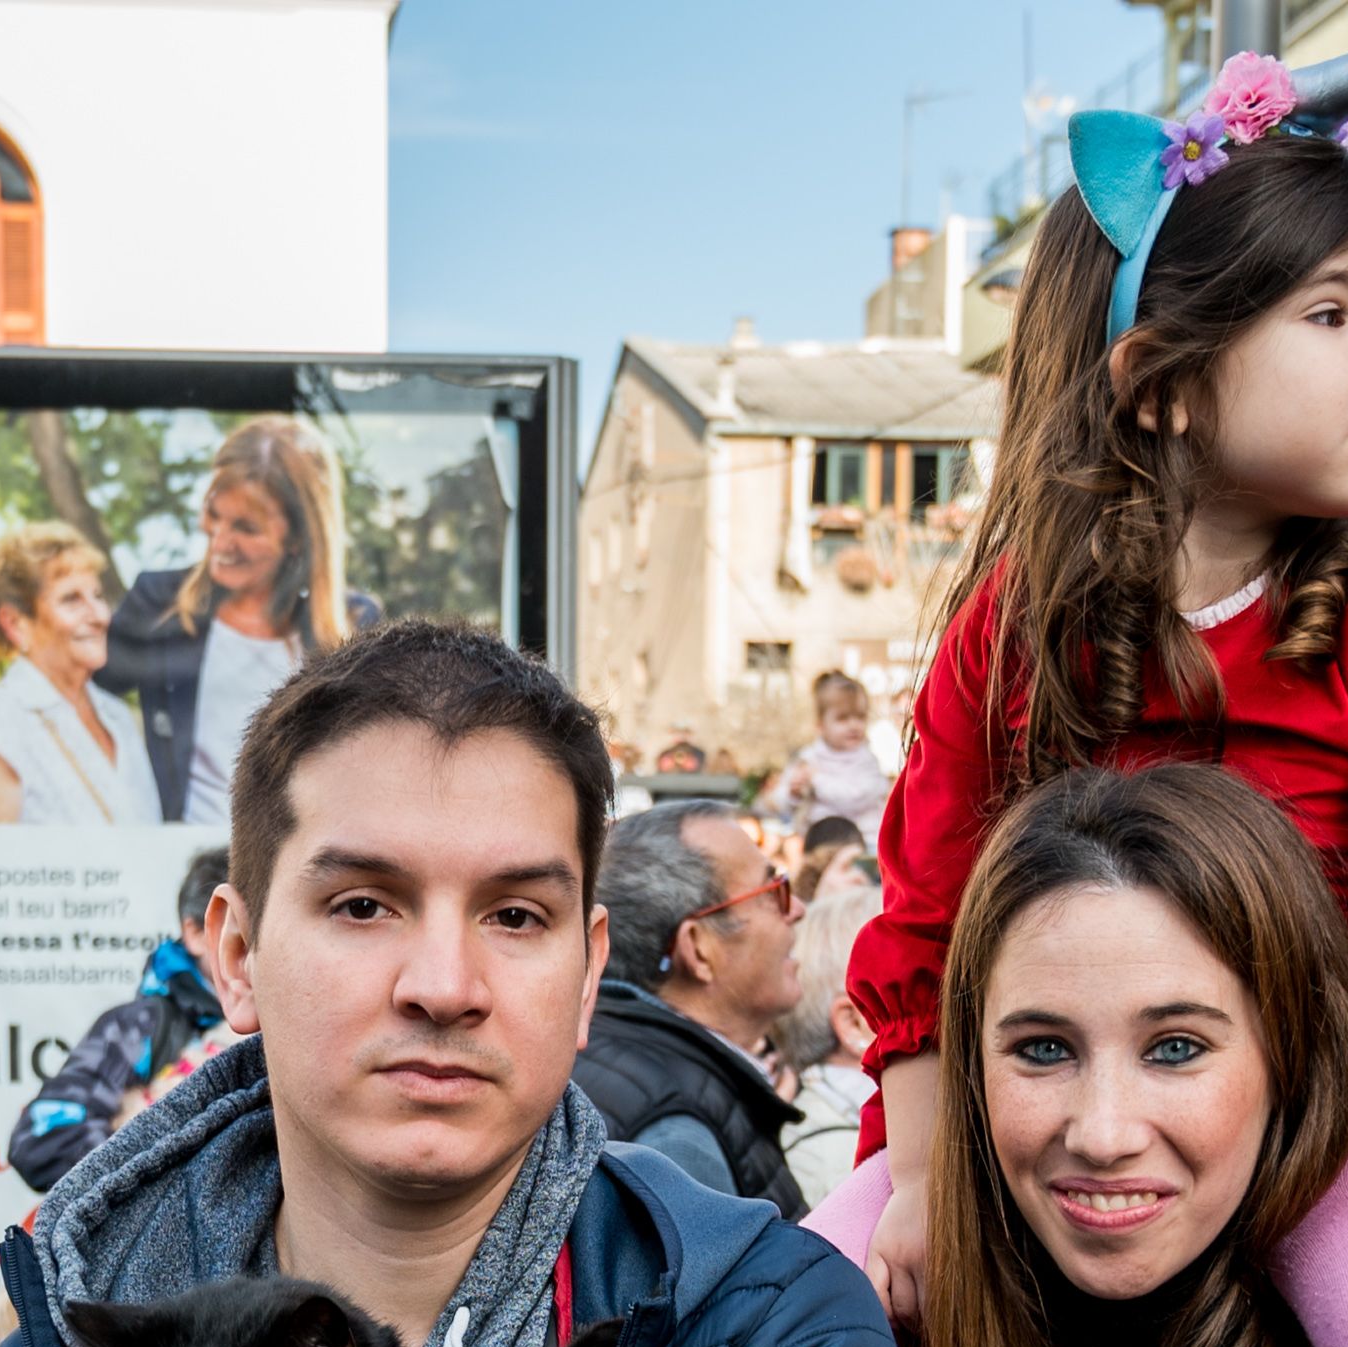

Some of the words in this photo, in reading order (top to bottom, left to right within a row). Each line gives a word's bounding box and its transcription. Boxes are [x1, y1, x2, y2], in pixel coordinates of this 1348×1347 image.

[85, 868, 122, 891] per
[18, 901, 53, 918] teu
[62, 900, 131, 919] barri?
